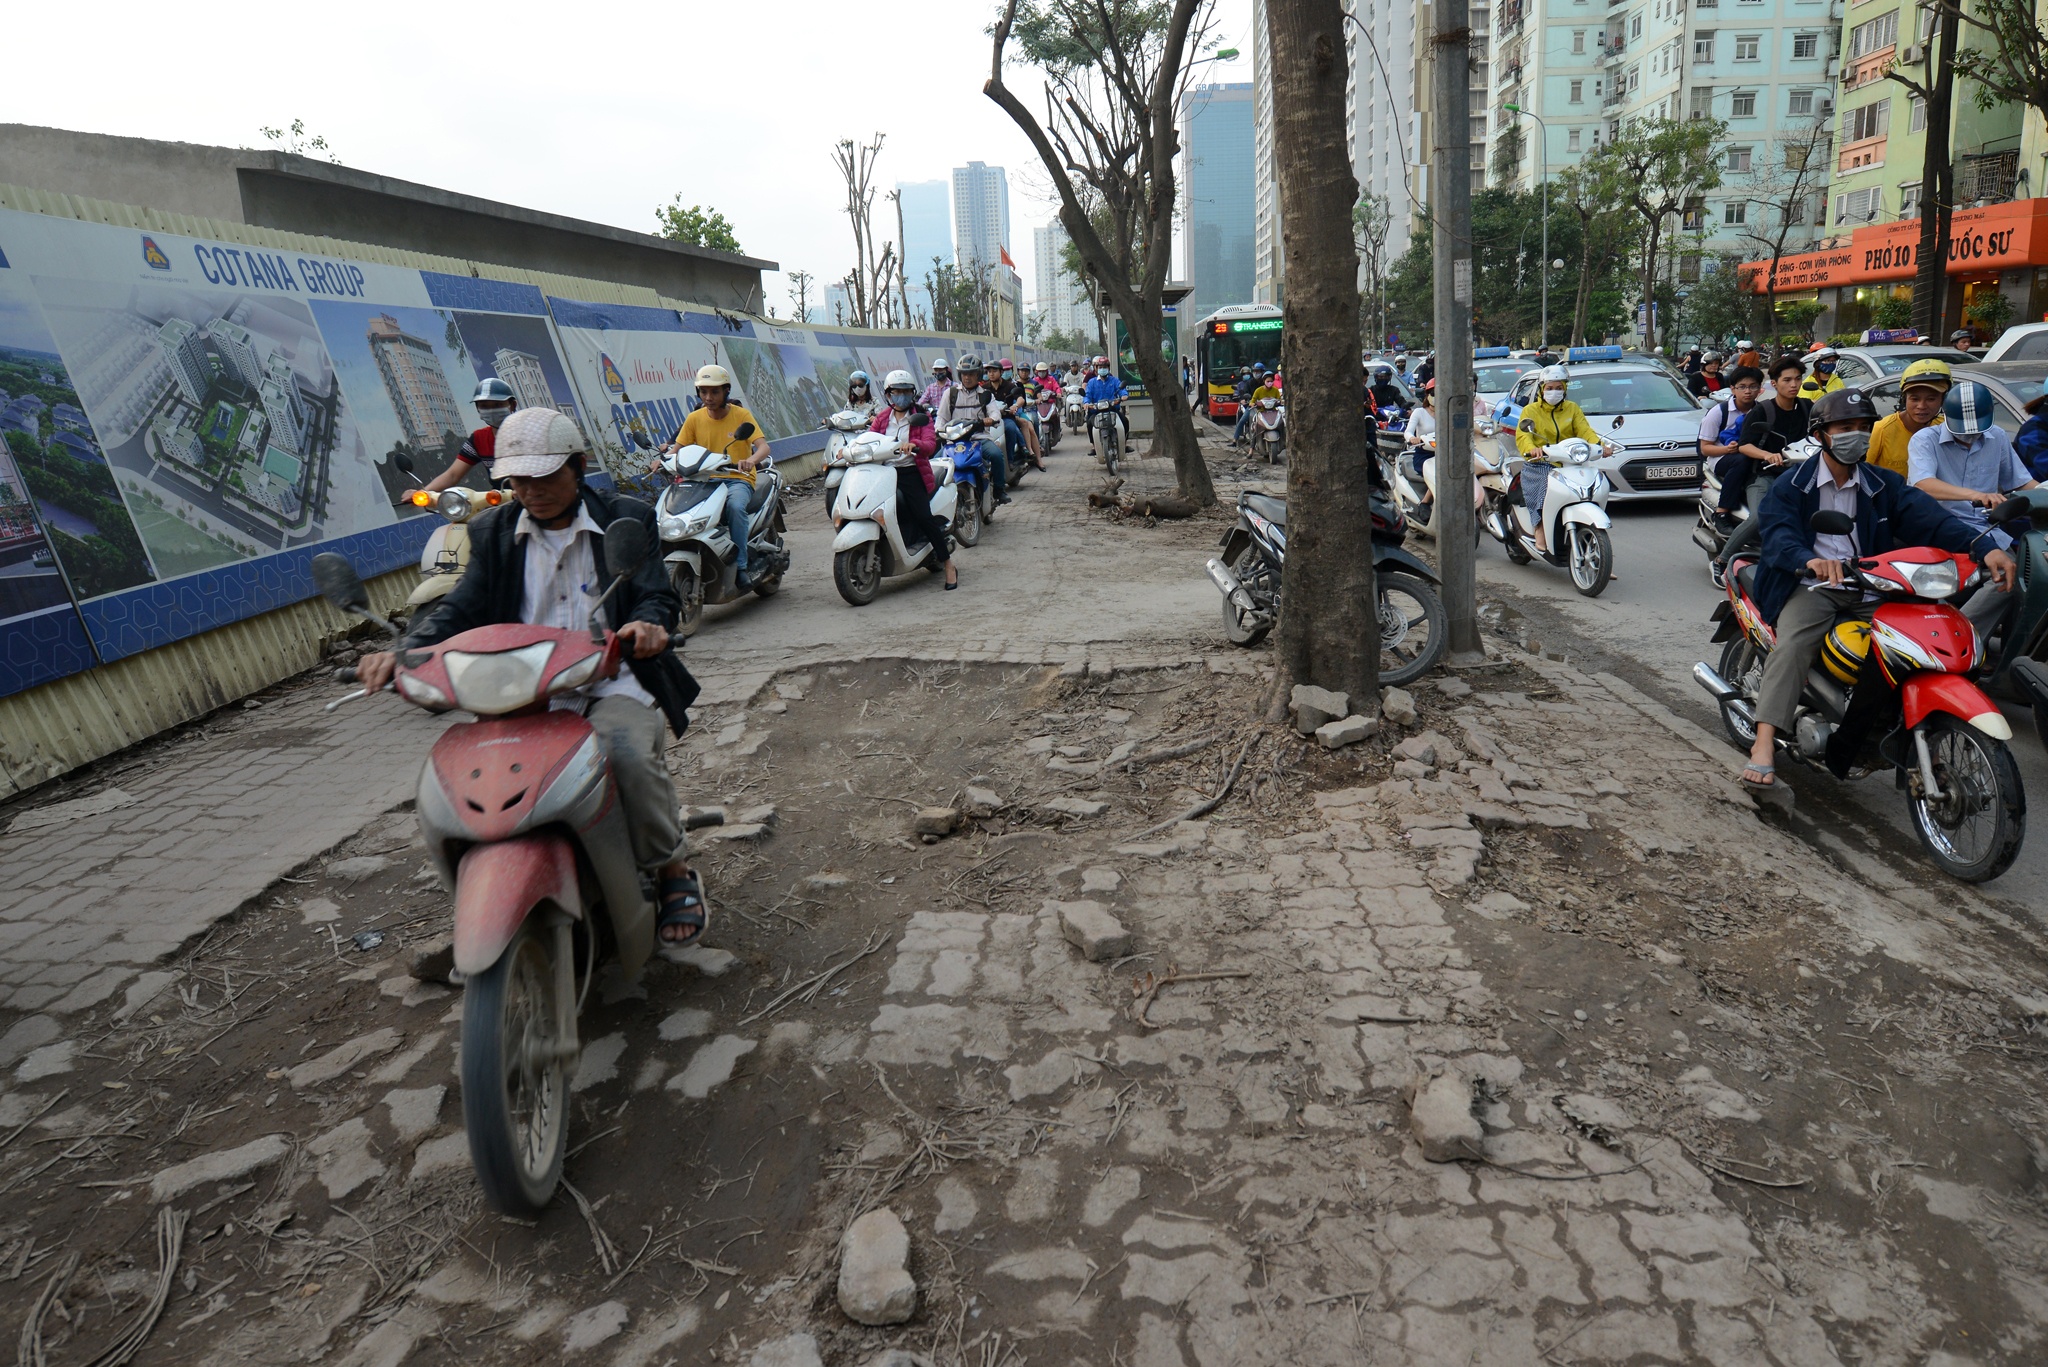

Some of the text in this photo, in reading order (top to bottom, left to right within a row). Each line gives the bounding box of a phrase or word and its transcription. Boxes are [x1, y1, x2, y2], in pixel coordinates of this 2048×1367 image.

[1865, 239, 1893, 270] PHỞ
[1893, 245, 1910, 267] 10
[1948, 227, 1984, 262] UỐC
[1987, 228, 2015, 257] SƯ
[194, 244, 365, 297] COTANA GROUP
[629, 358, 665, 385] Main
[1648, 466, 1696, 478] 30E-055.90
[475, 736, 522, 749] HONDA
